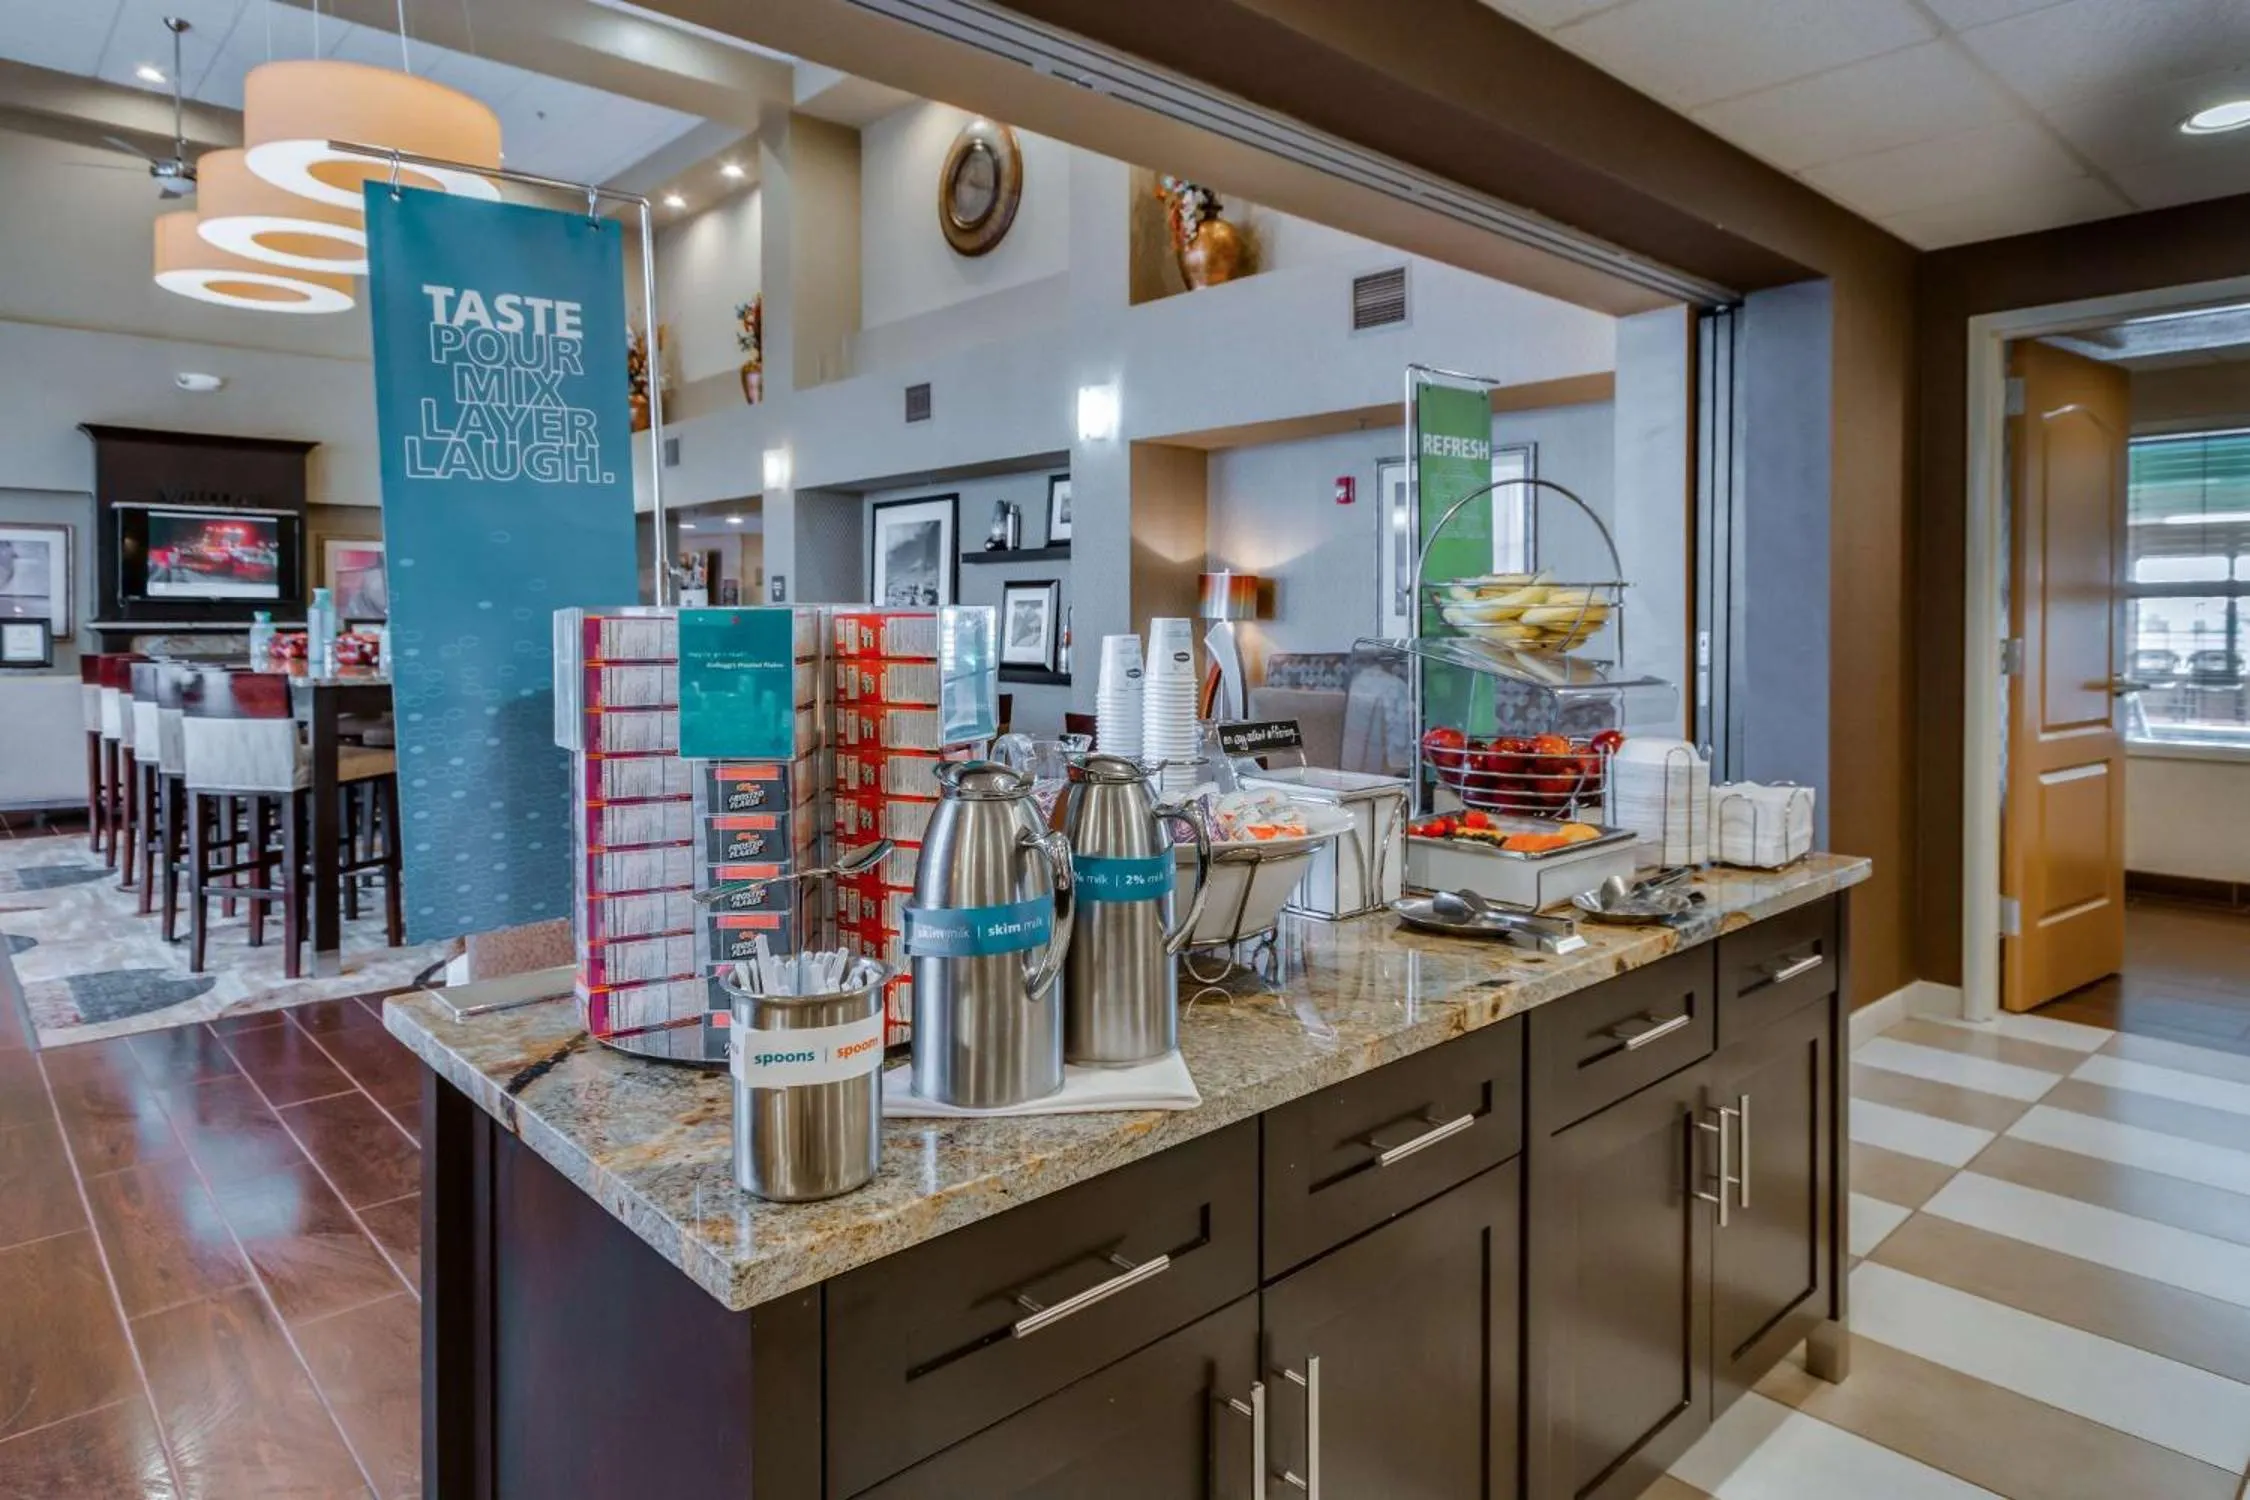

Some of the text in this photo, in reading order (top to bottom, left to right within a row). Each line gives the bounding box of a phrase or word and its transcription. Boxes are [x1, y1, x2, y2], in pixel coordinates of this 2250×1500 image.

[422, 284, 584, 339] TASTE
[430, 322, 584, 376] POUR
[454, 362, 568, 410] MIX
[421, 398, 600, 448] LAYER
[1423, 433, 1489, 460] REFRESH
[405, 436, 616, 485] LAUGH.
[1126, 874, 1146, 886] 2%
[987, 922, 1021, 938] skim
[754, 1050, 815, 1067] spoons
